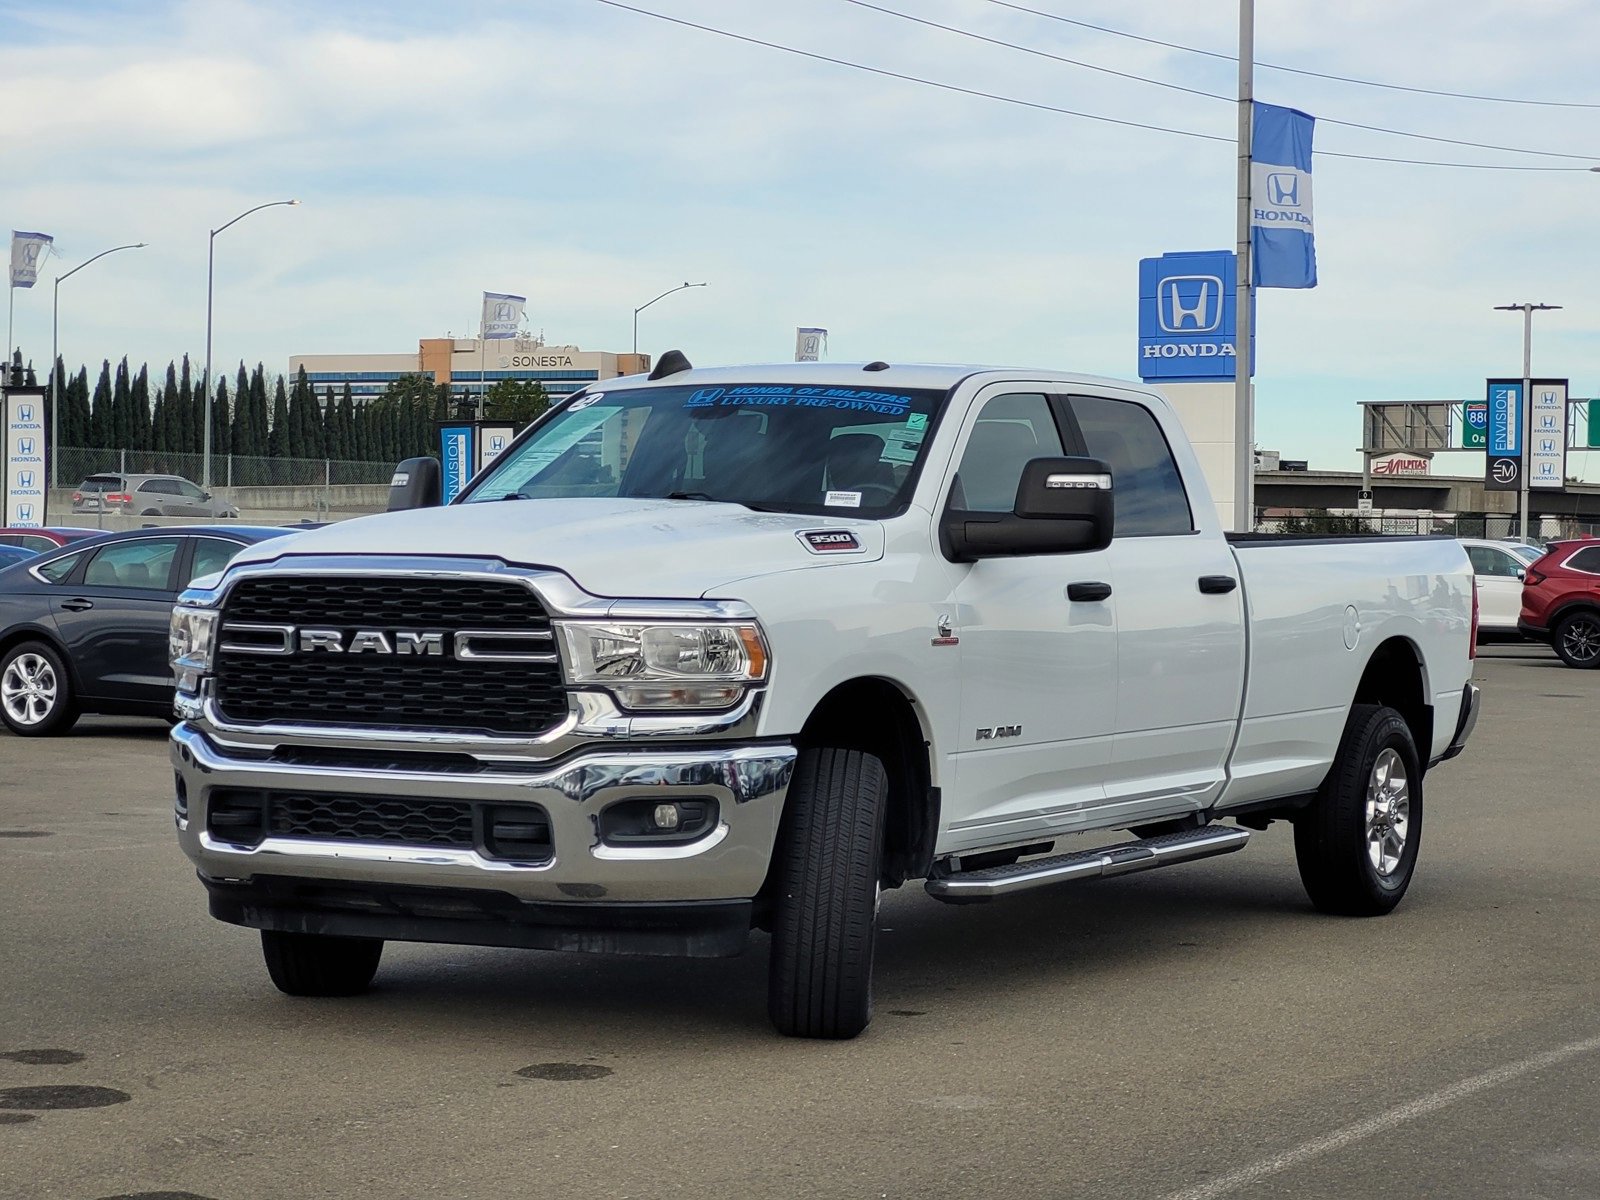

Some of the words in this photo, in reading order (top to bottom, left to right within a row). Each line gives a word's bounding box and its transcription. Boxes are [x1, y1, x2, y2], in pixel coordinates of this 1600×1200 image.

[1254, 209, 1312, 226] HONDA
[1143, 342, 1236, 358] HONDA
[512, 356, 573, 367] SONESTA
[728, 386, 794, 395] HONDA
[795, 387, 825, 395] OF
[822, 388, 912, 404] MILPITAS
[720, 397, 793, 406] LUXURY
[794, 398, 905, 415] PRE-OWNED
[1495, 389, 1507, 451] ENVISION
[1373, 458, 1427, 475] MILPITAS
[810, 534, 853, 544] 3500
[300, 630, 444, 655] RAM
[976, 725, 1022, 741] RAM
